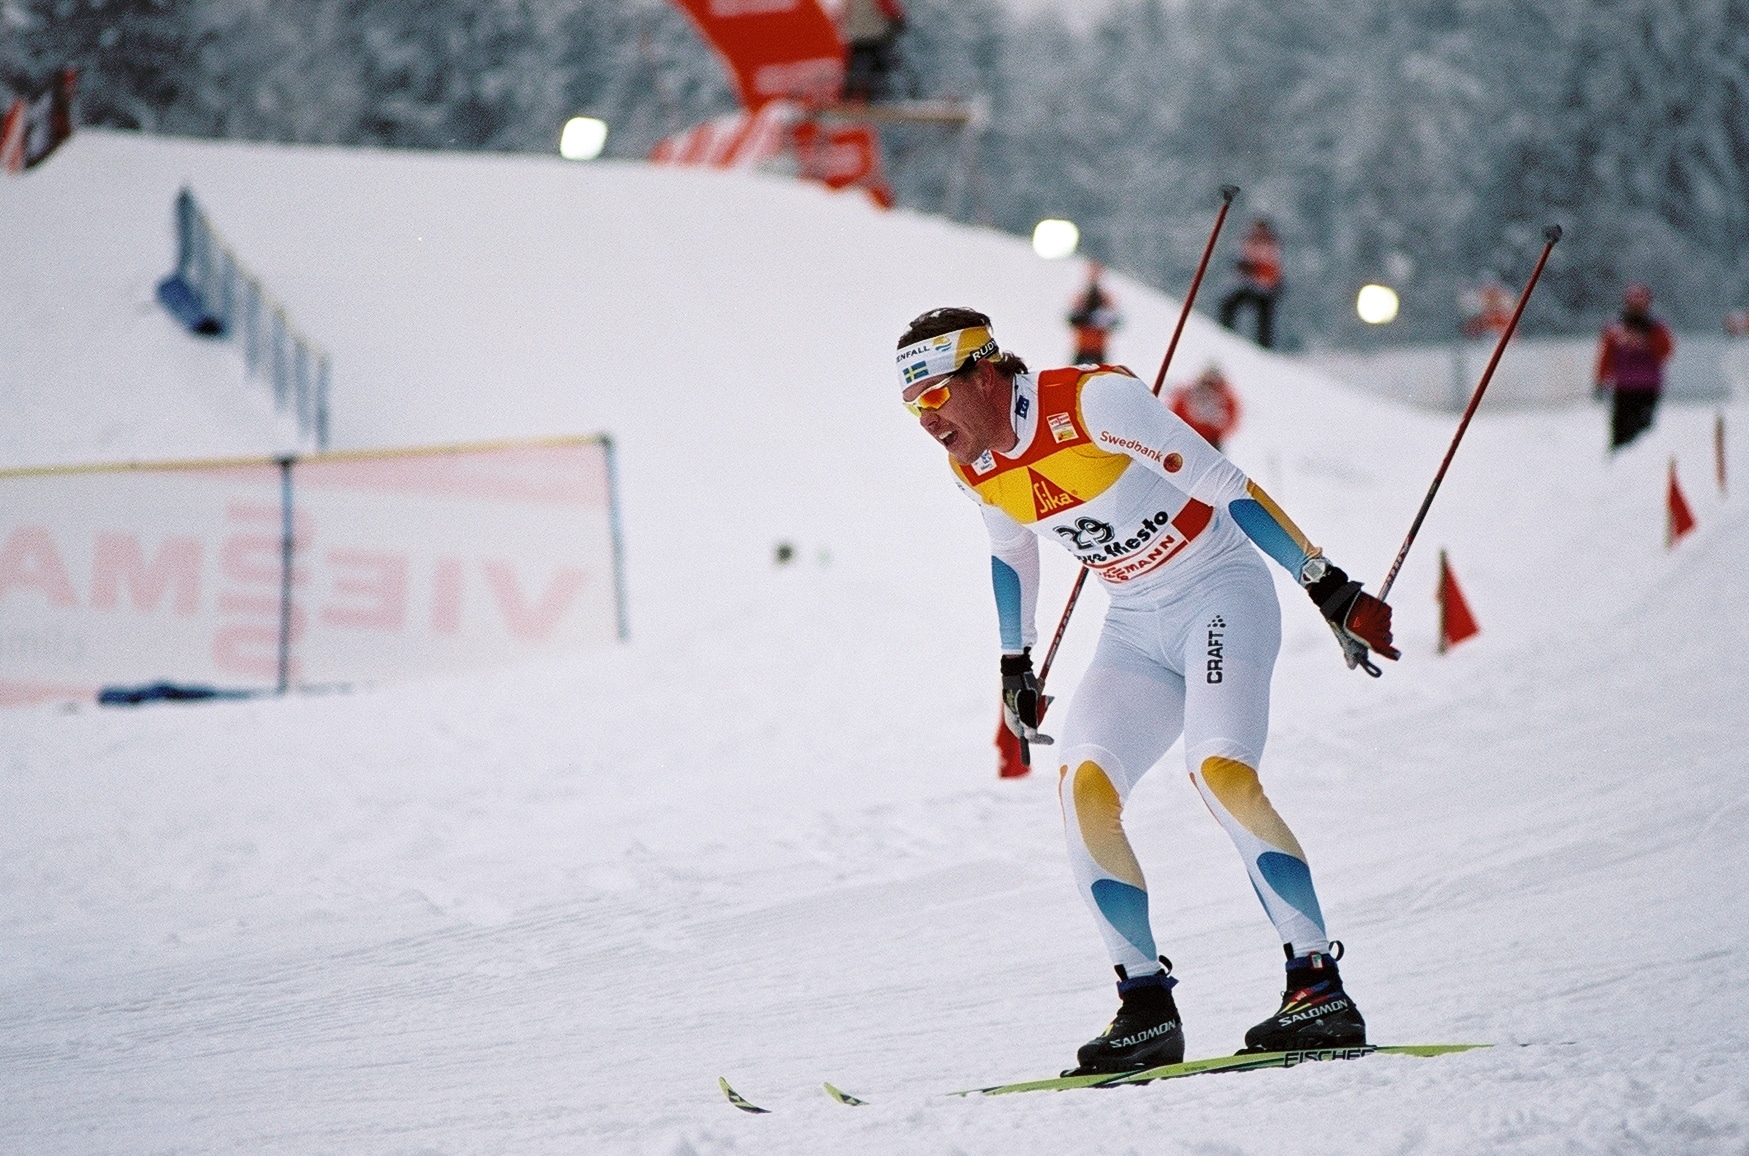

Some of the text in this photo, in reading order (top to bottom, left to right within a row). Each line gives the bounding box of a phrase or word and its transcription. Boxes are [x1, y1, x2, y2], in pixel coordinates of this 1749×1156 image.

[1100, 430, 1163, 463] Swedbank
[1033, 480, 1074, 514] Sika
[1052, 516, 1116, 550] 29
[1206, 630, 1224, 684] CRAFT
[1278, 998, 1349, 1027] SALOMON
[1109, 1018, 1177, 1049] SALOMON
